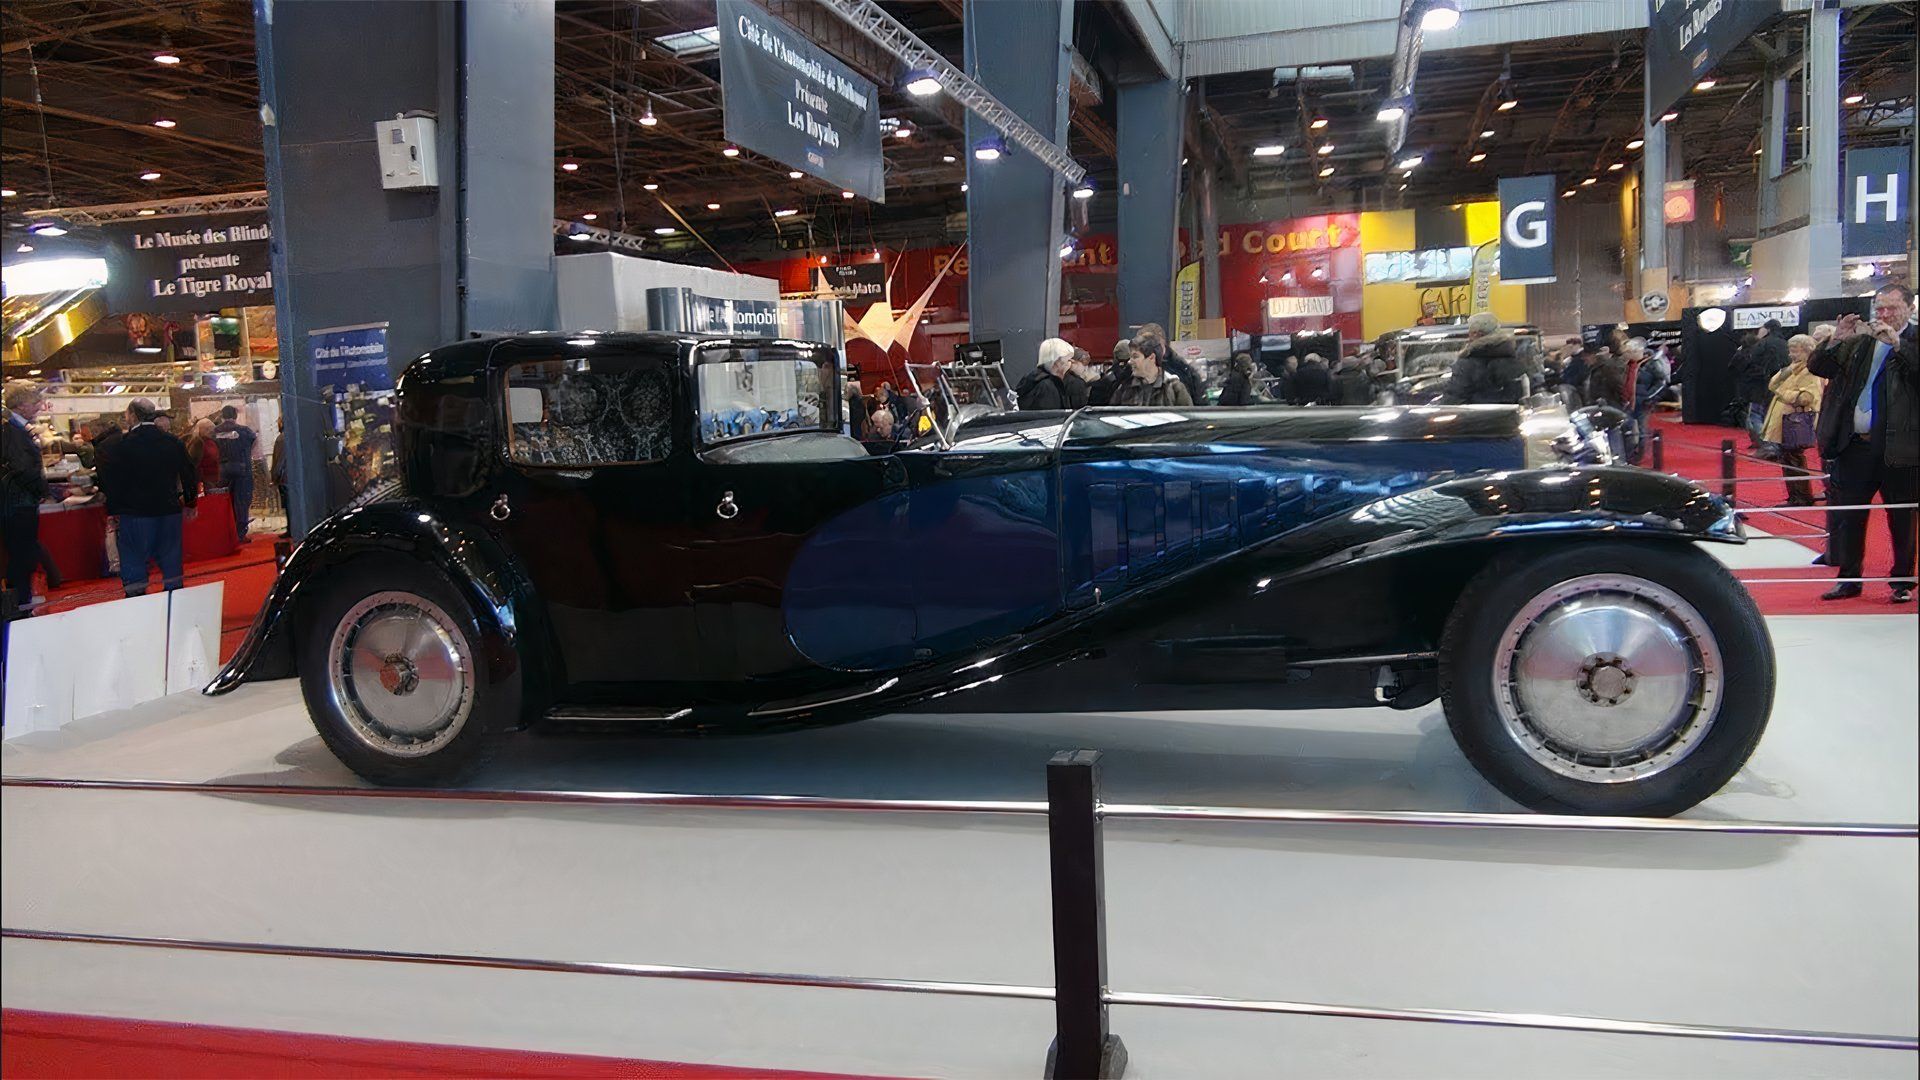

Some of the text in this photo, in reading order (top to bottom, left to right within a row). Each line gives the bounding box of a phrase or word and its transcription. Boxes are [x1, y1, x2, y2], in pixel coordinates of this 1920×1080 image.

[738, 15, 760, 46] Cité
[762, 29, 773, 54] de
[827, 70, 836, 92] de
[787, 101, 840, 149] Les Royales
[1855, 173, 1898, 223] H
[133, 223, 272, 250] Le Musée des Blind
[1243, 223, 1342, 254] Court
[1504, 200, 1547, 249] G
[180, 253, 240, 274] présente
[153, 271, 272, 298] Le Tigre Royal
